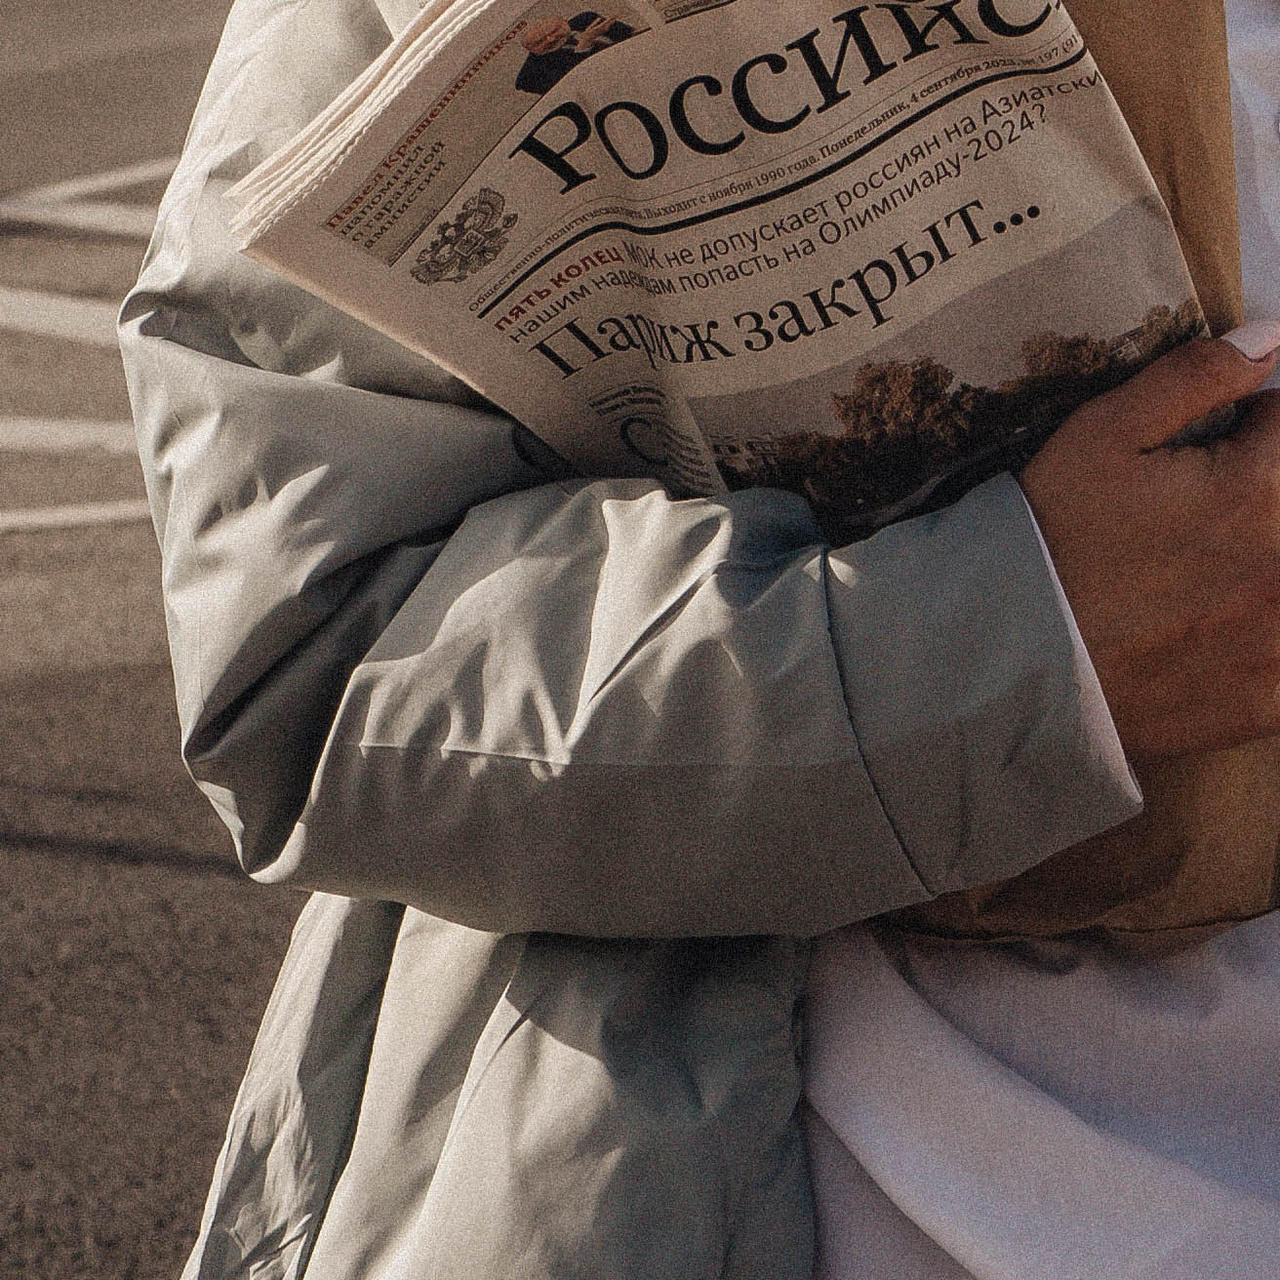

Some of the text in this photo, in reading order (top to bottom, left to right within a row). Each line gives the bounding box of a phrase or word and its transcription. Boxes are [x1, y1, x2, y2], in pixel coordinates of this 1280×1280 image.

[340, 144, 426, 238] напомнил
[667, 247, 696, 269] не
[699, 199, 829, 262] допускает
[833, 133, 942, 214] россиян
[943, 115, 978, 141] на
[699, 194, 708, 205] с
[755, 167, 786, 188] 1990
[819, 98, 910, 160] Понедельник,
[909, 92, 920, 105] 4
[919, 62, 984, 100] сентября
[327, 171, 385, 230] Павел
[509, 284, 593, 344] нашим
[679, 251, 780, 295] попасть
[782, 238, 817, 263] на
[818, 102, 1048, 246] Олимпиаду-2024?
[527, 312, 737, 381] Париж
